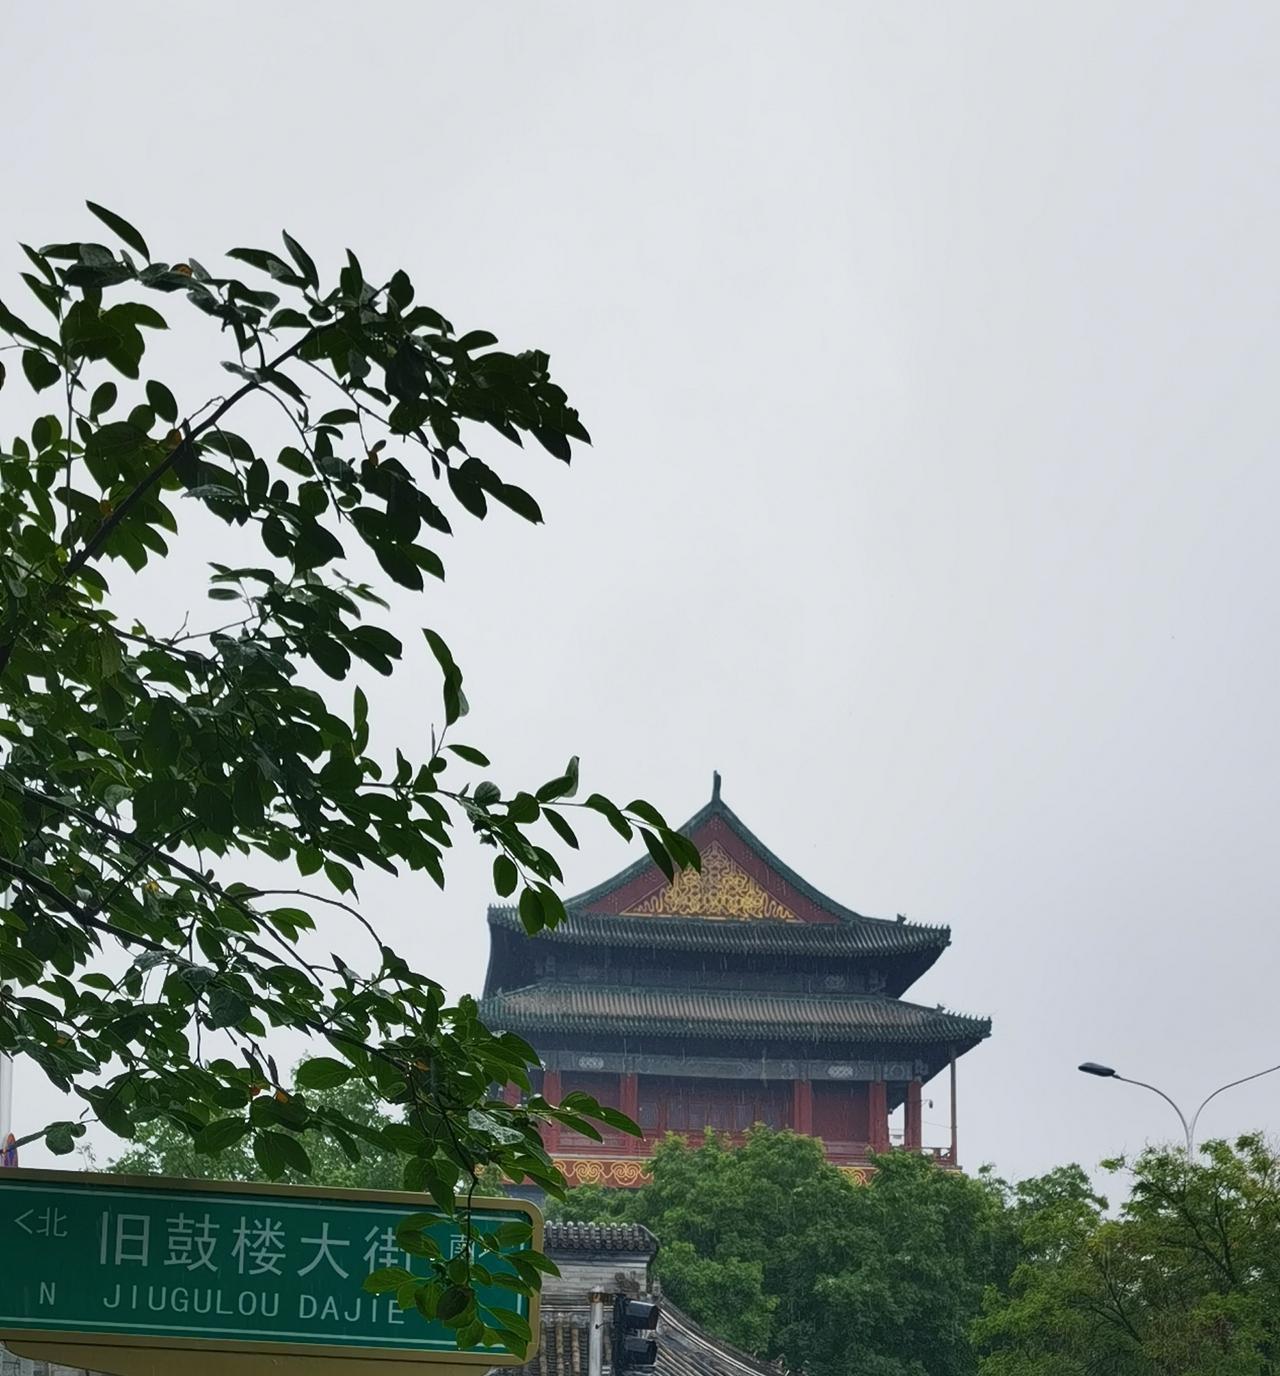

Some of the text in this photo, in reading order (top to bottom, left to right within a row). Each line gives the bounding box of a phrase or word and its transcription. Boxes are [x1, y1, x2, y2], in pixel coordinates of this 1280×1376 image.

[36, 1207, 68, 1237] 北
[100, 1211, 412, 1279] 旧鼓楼大街
[40, 1281, 405, 1325] N JIUGULOU DAJIE
